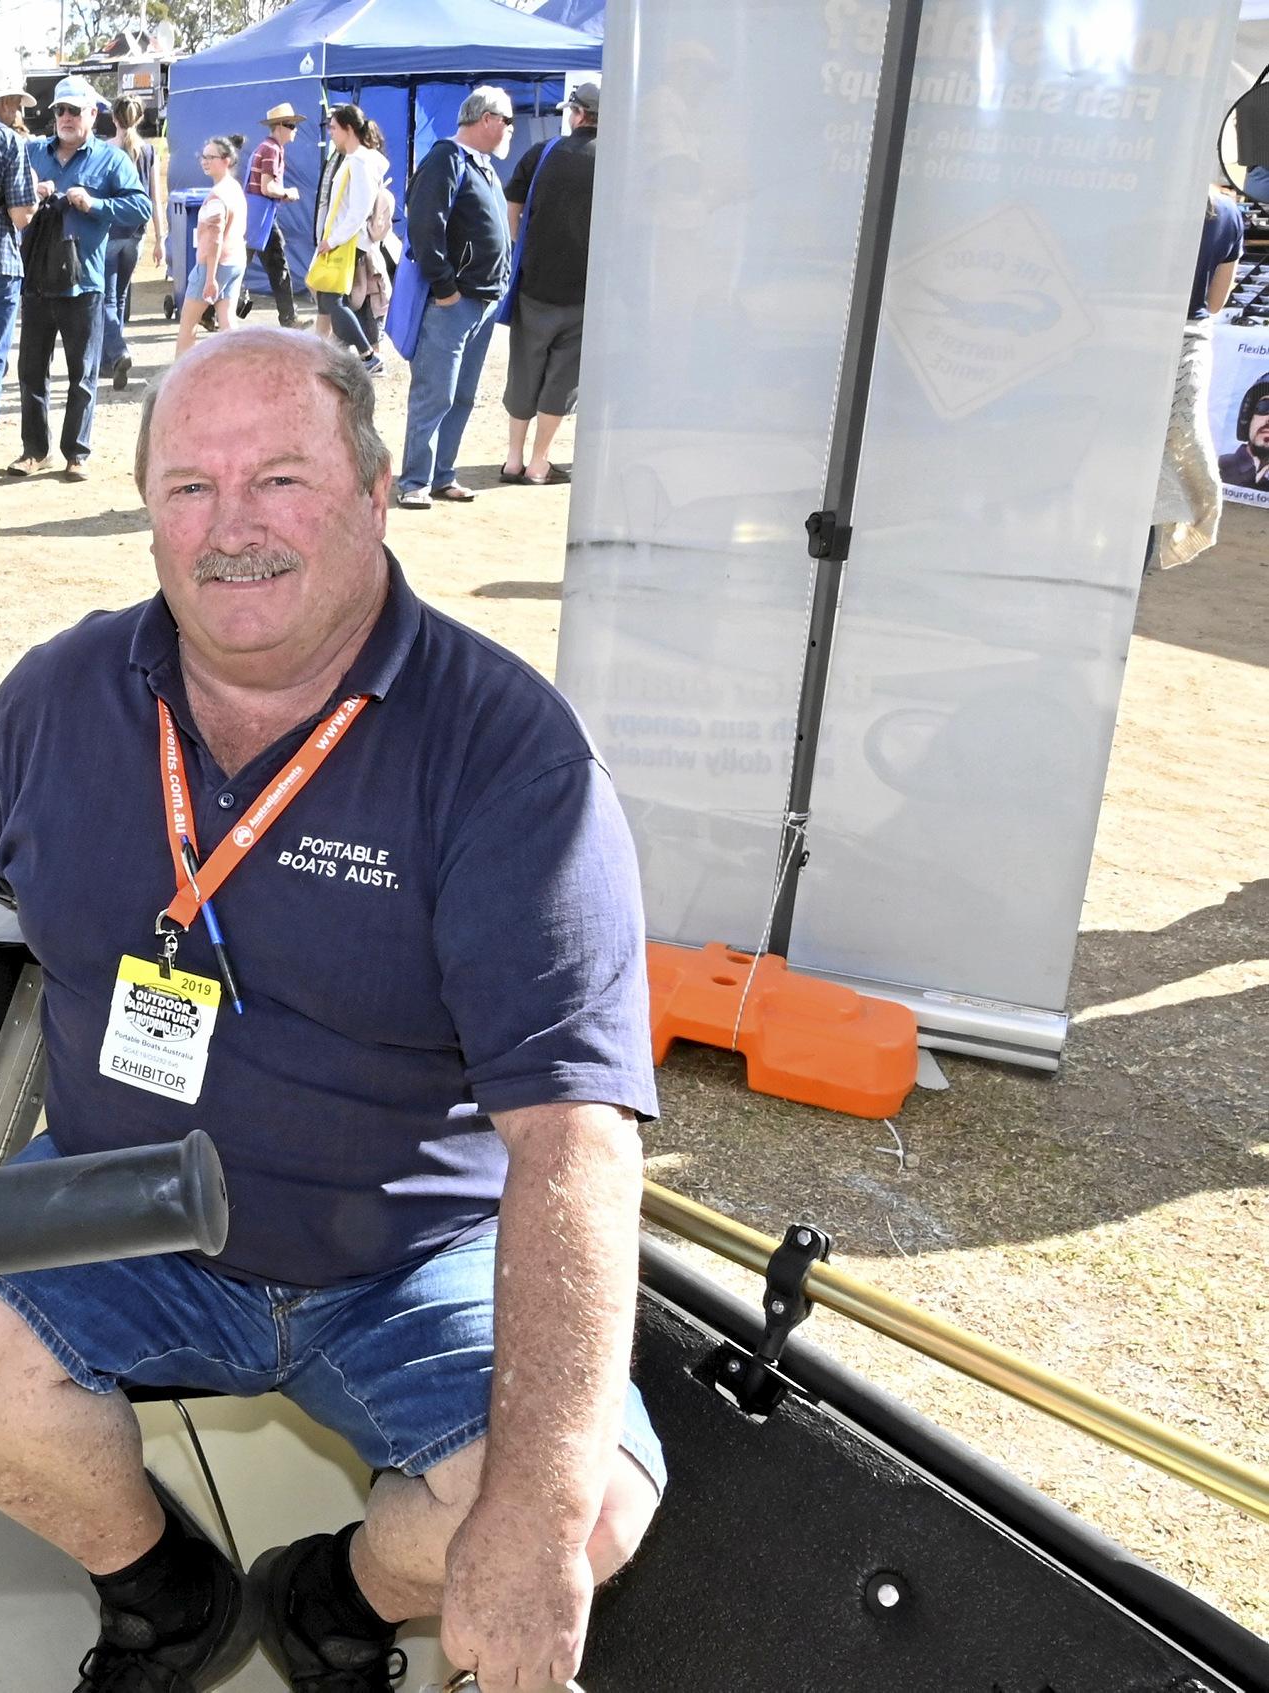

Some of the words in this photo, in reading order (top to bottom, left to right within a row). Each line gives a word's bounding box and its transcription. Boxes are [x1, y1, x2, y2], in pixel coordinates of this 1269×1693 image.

[298, 836, 389, 866] PORTABLE
[277, 851, 337, 877] BOATS
[344, 865, 400, 889] AUST.
[181, 977, 212, 996] 2019
[127, 998, 197, 1027] ADVENTURE
[135, 990, 192, 1014] OUTDOOR
[141, 1039, 161, 1052] Boats
[162, 1046, 194, 1061] Australia
[112, 1055, 186, 1090] EXHIBITOR
